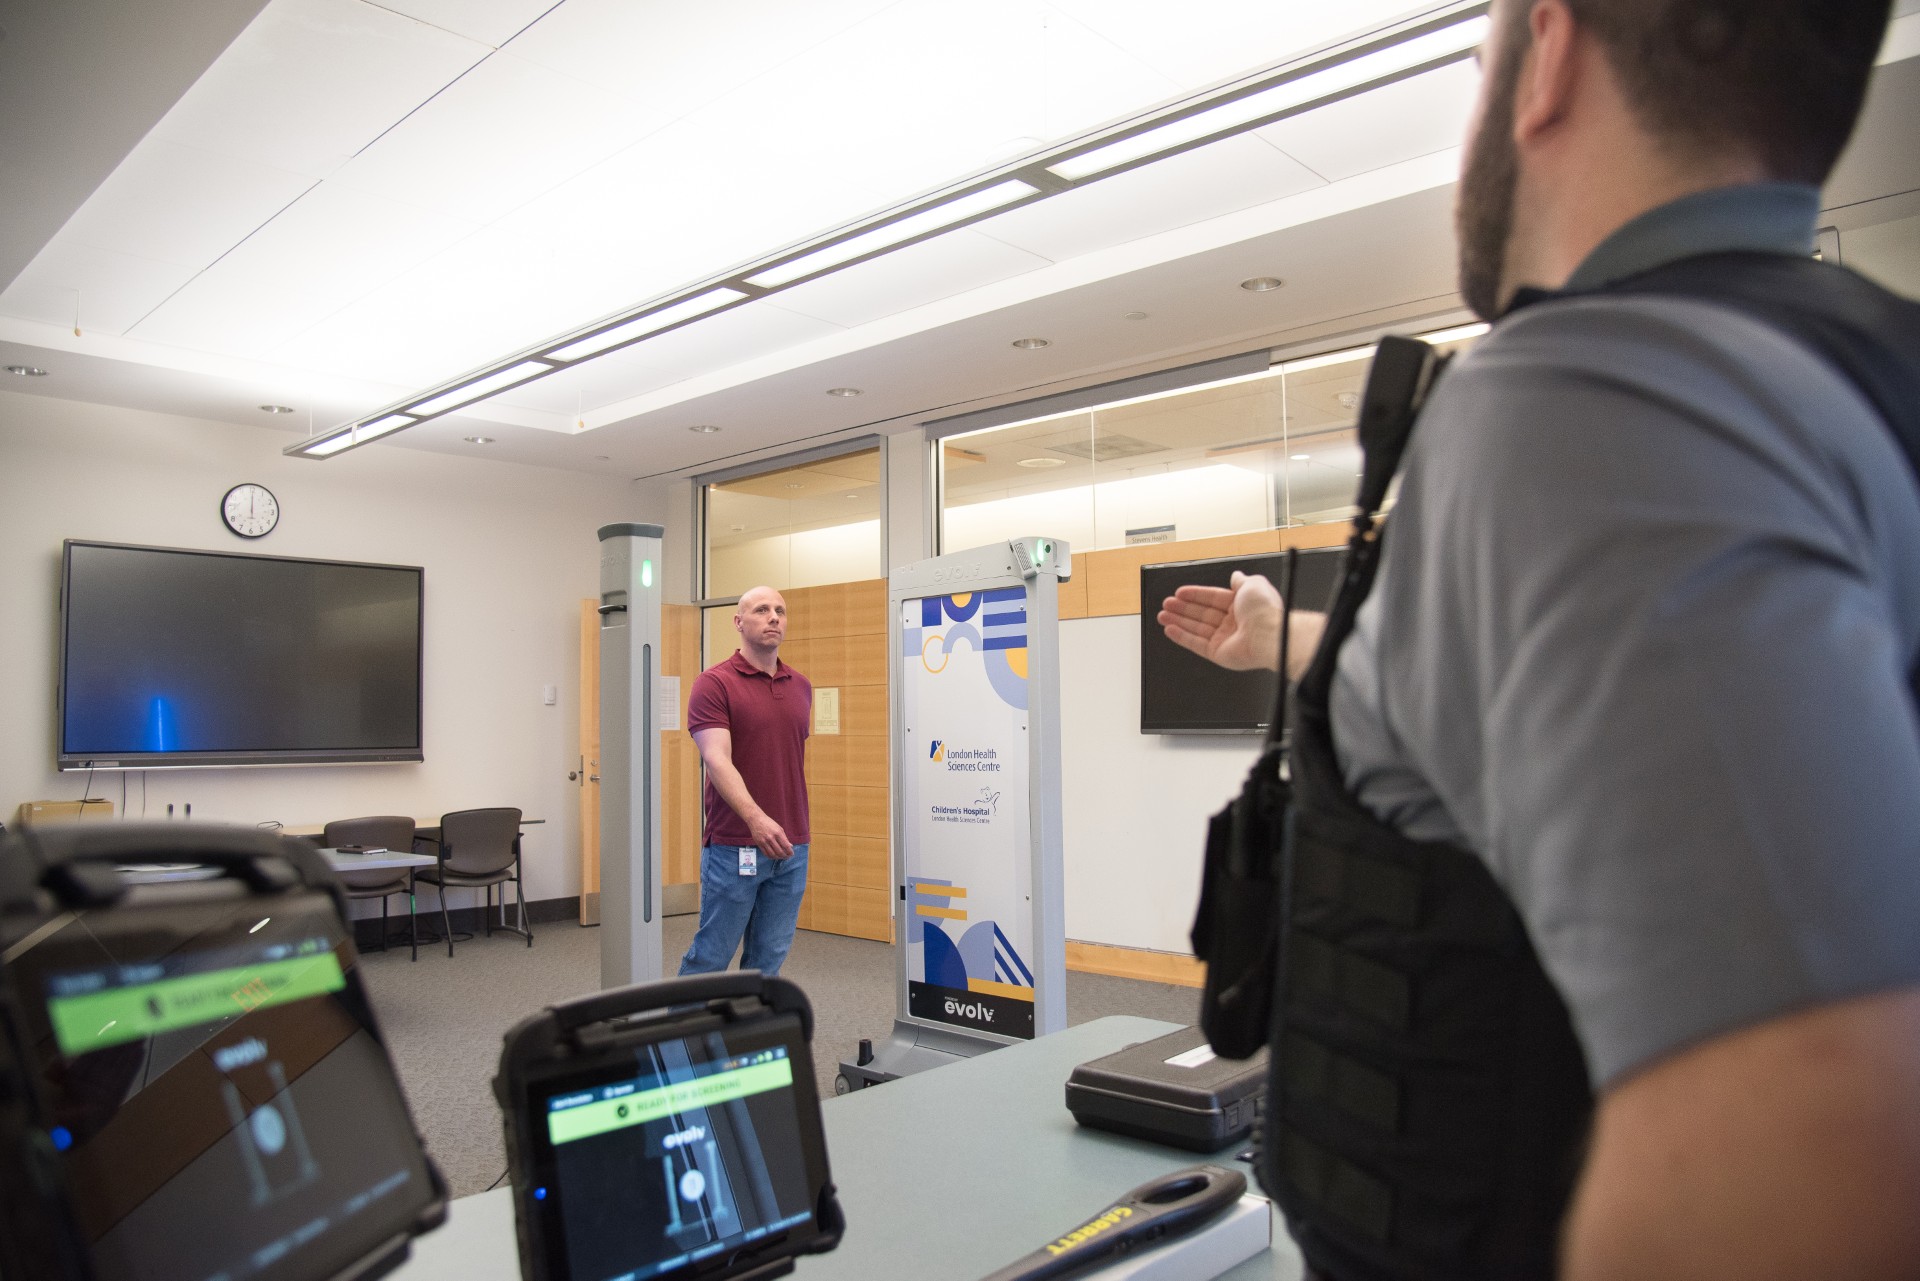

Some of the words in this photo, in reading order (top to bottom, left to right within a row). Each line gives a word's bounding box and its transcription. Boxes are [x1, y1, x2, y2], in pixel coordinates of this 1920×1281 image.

[947, 748, 972, 759] London
[973, 748, 997, 759] Health
[947, 760, 976, 772] Sciences
[977, 761, 1001, 772] Centre
[931, 805, 962, 815] Children's
[963, 807, 990, 817] Hospital
[944, 1000, 995, 1023] evolv
[1046, 1207, 1133, 1256] GARRETT
